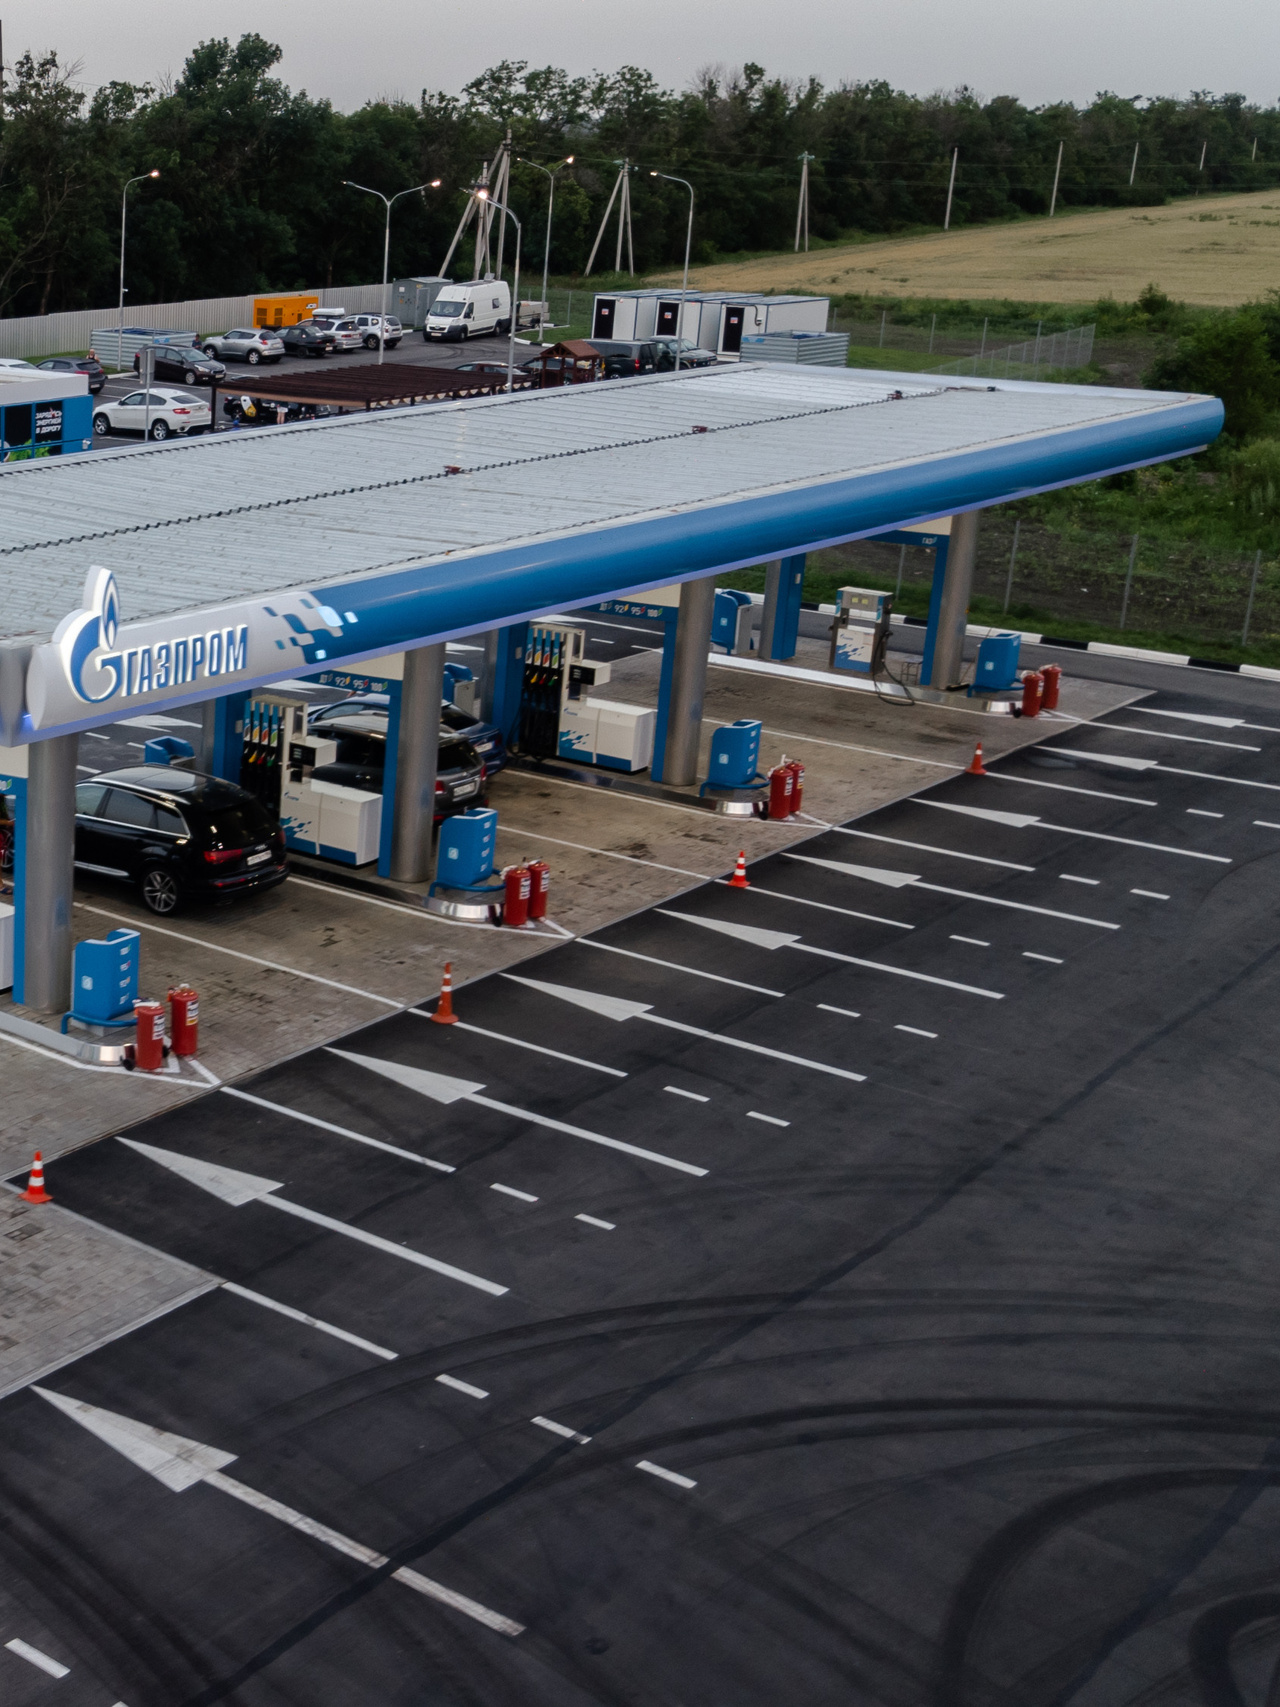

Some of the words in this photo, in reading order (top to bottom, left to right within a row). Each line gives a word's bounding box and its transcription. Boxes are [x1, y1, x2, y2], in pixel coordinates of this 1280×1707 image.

[614, 604, 625, 613] 92
[630, 606, 641, 616] 95
[120, 624, 248, 697] ГАЗПРОМ
[334, 676, 346, 687] 92
[352, 679, 364, 690] 95
